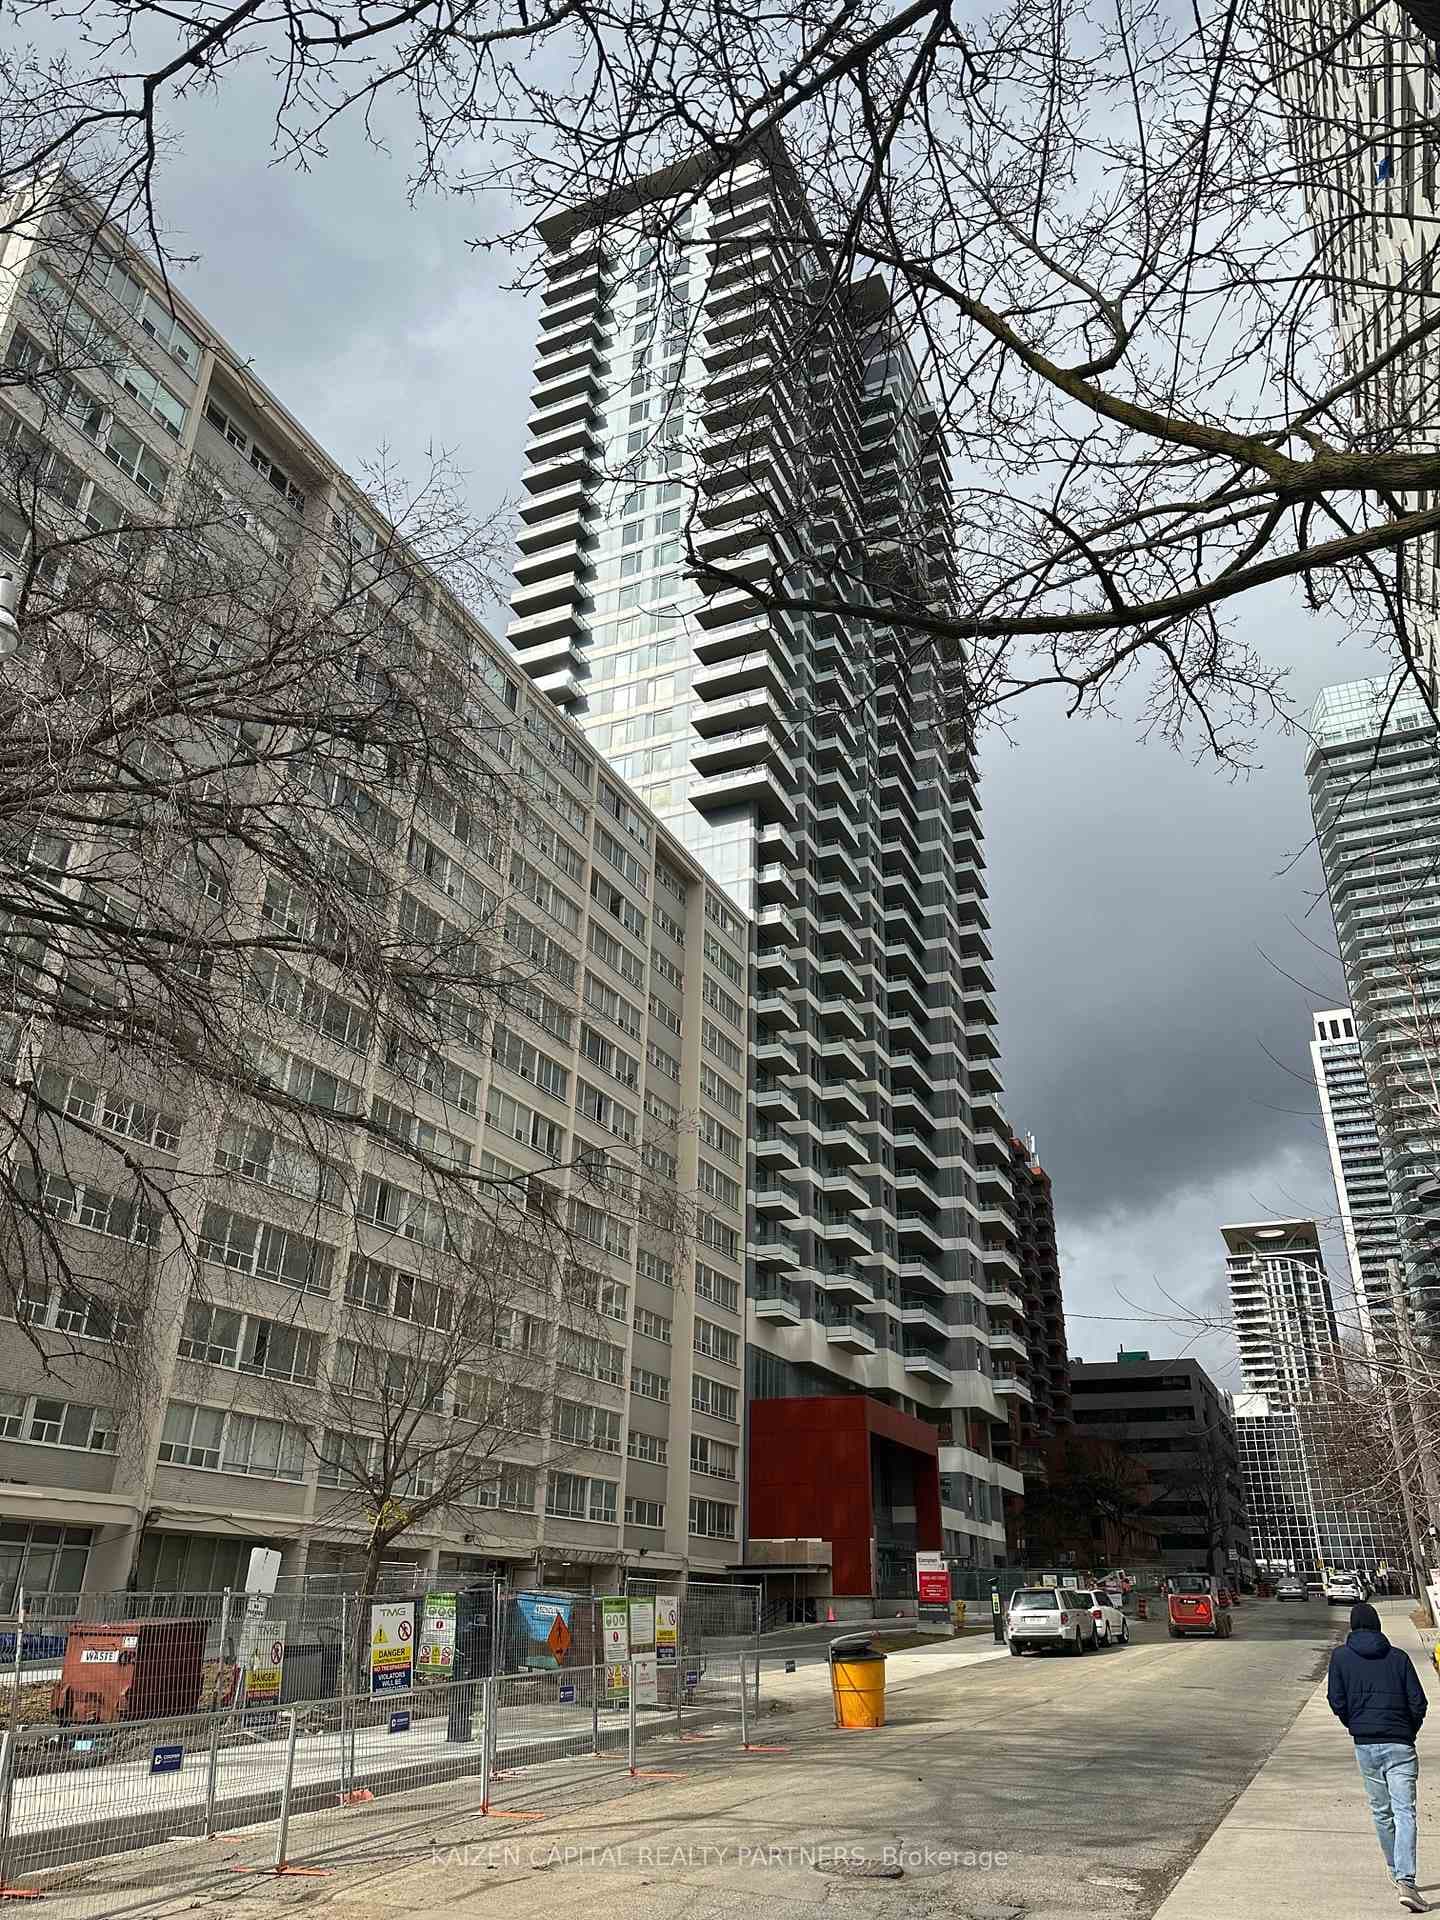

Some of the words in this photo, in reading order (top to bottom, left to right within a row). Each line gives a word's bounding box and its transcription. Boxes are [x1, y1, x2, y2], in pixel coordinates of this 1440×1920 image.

[379, 1607, 406, 1617] TMG
[86, 1651, 114, 1662] WASTE
[378, 1648, 405, 1659] DANGER
[378, 1672, 405, 1681] VIOLATORS
[382, 1679, 394, 1688] WILL
[395, 1678, 402, 1686] BE
